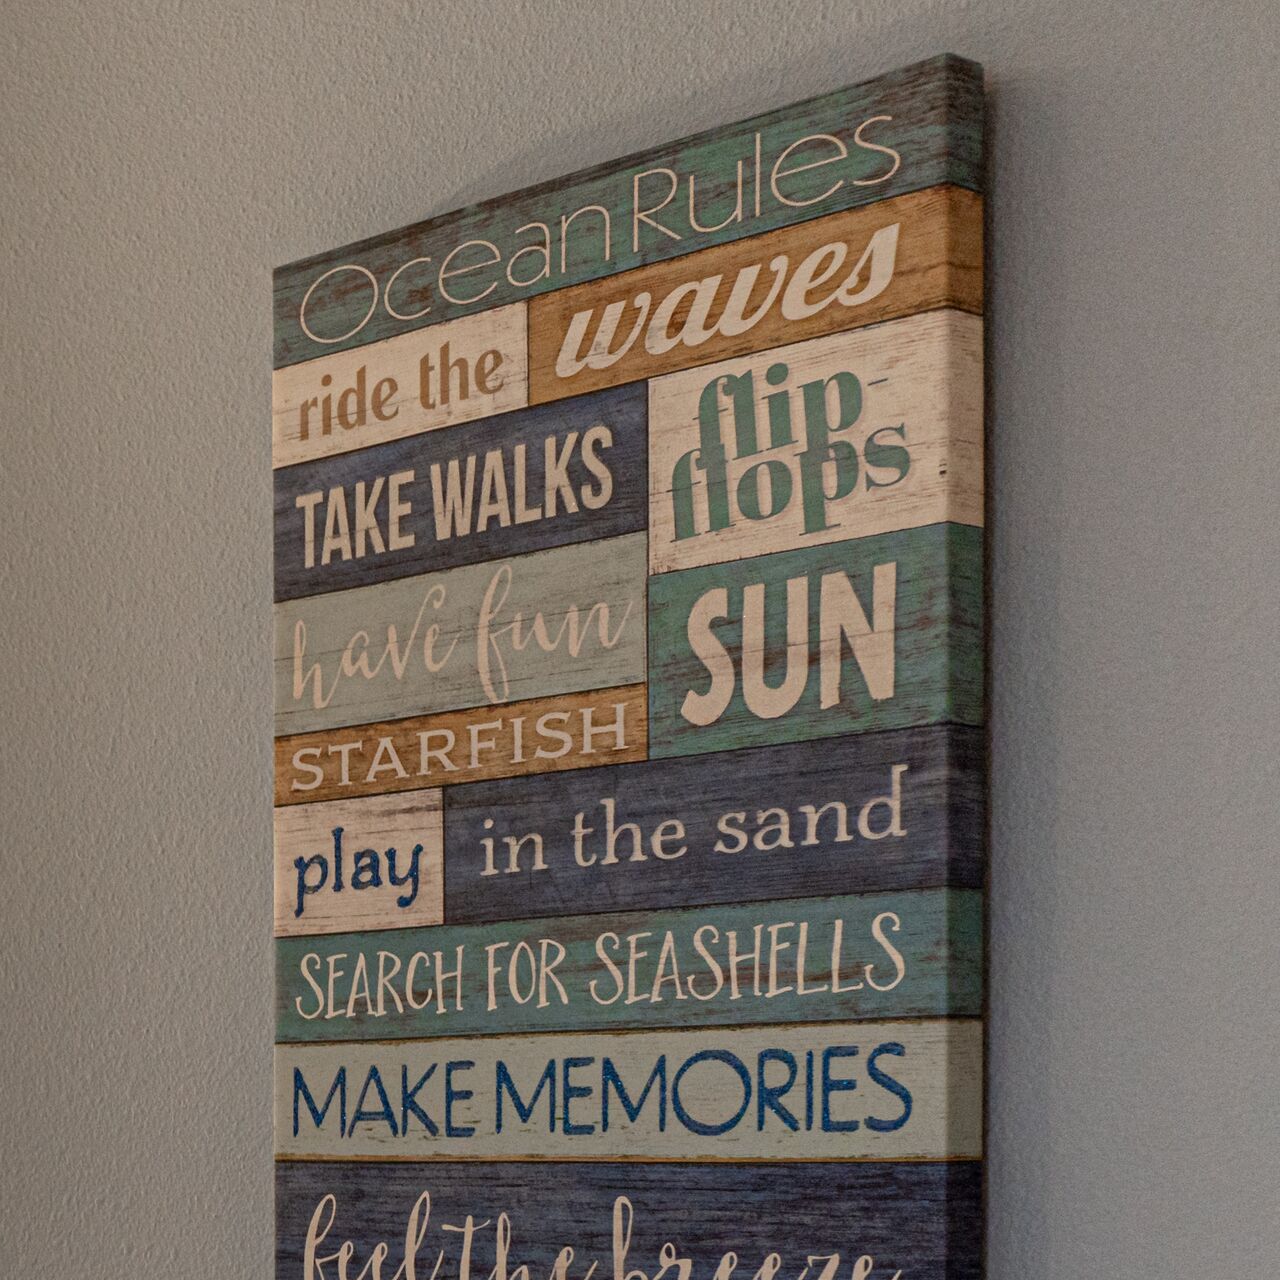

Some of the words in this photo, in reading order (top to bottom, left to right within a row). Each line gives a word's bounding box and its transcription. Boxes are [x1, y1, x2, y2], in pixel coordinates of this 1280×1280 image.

[299, 203, 611, 345] Ocean
[633, 115, 902, 252] Rules
[554, 222, 901, 378] waves
[297, 374, 401, 442] ride
[419, 341, 506, 410] the
[294, 478, 416, 569] TAKE
[430, 425, 615, 544] WALKS
[666, 423, 912, 543] flops
[292, 584, 463, 710] have
[466, 566, 633, 704] fun
[680, 562, 898, 728] SUN
[289, 702, 630, 792] STARFISH
[293, 827, 425, 918] play
[478, 819, 548, 877] in
[570, 798, 689, 868] the
[714, 764, 909, 855] sand
[294, 945, 465, 1020] SEARCH
[486, 938, 570, 1012] FOR
[588, 912, 907, 1004] SEASHELLS
[292, 1060, 476, 1138] MAKE
[495, 1042, 914, 1136] MEMORIES
